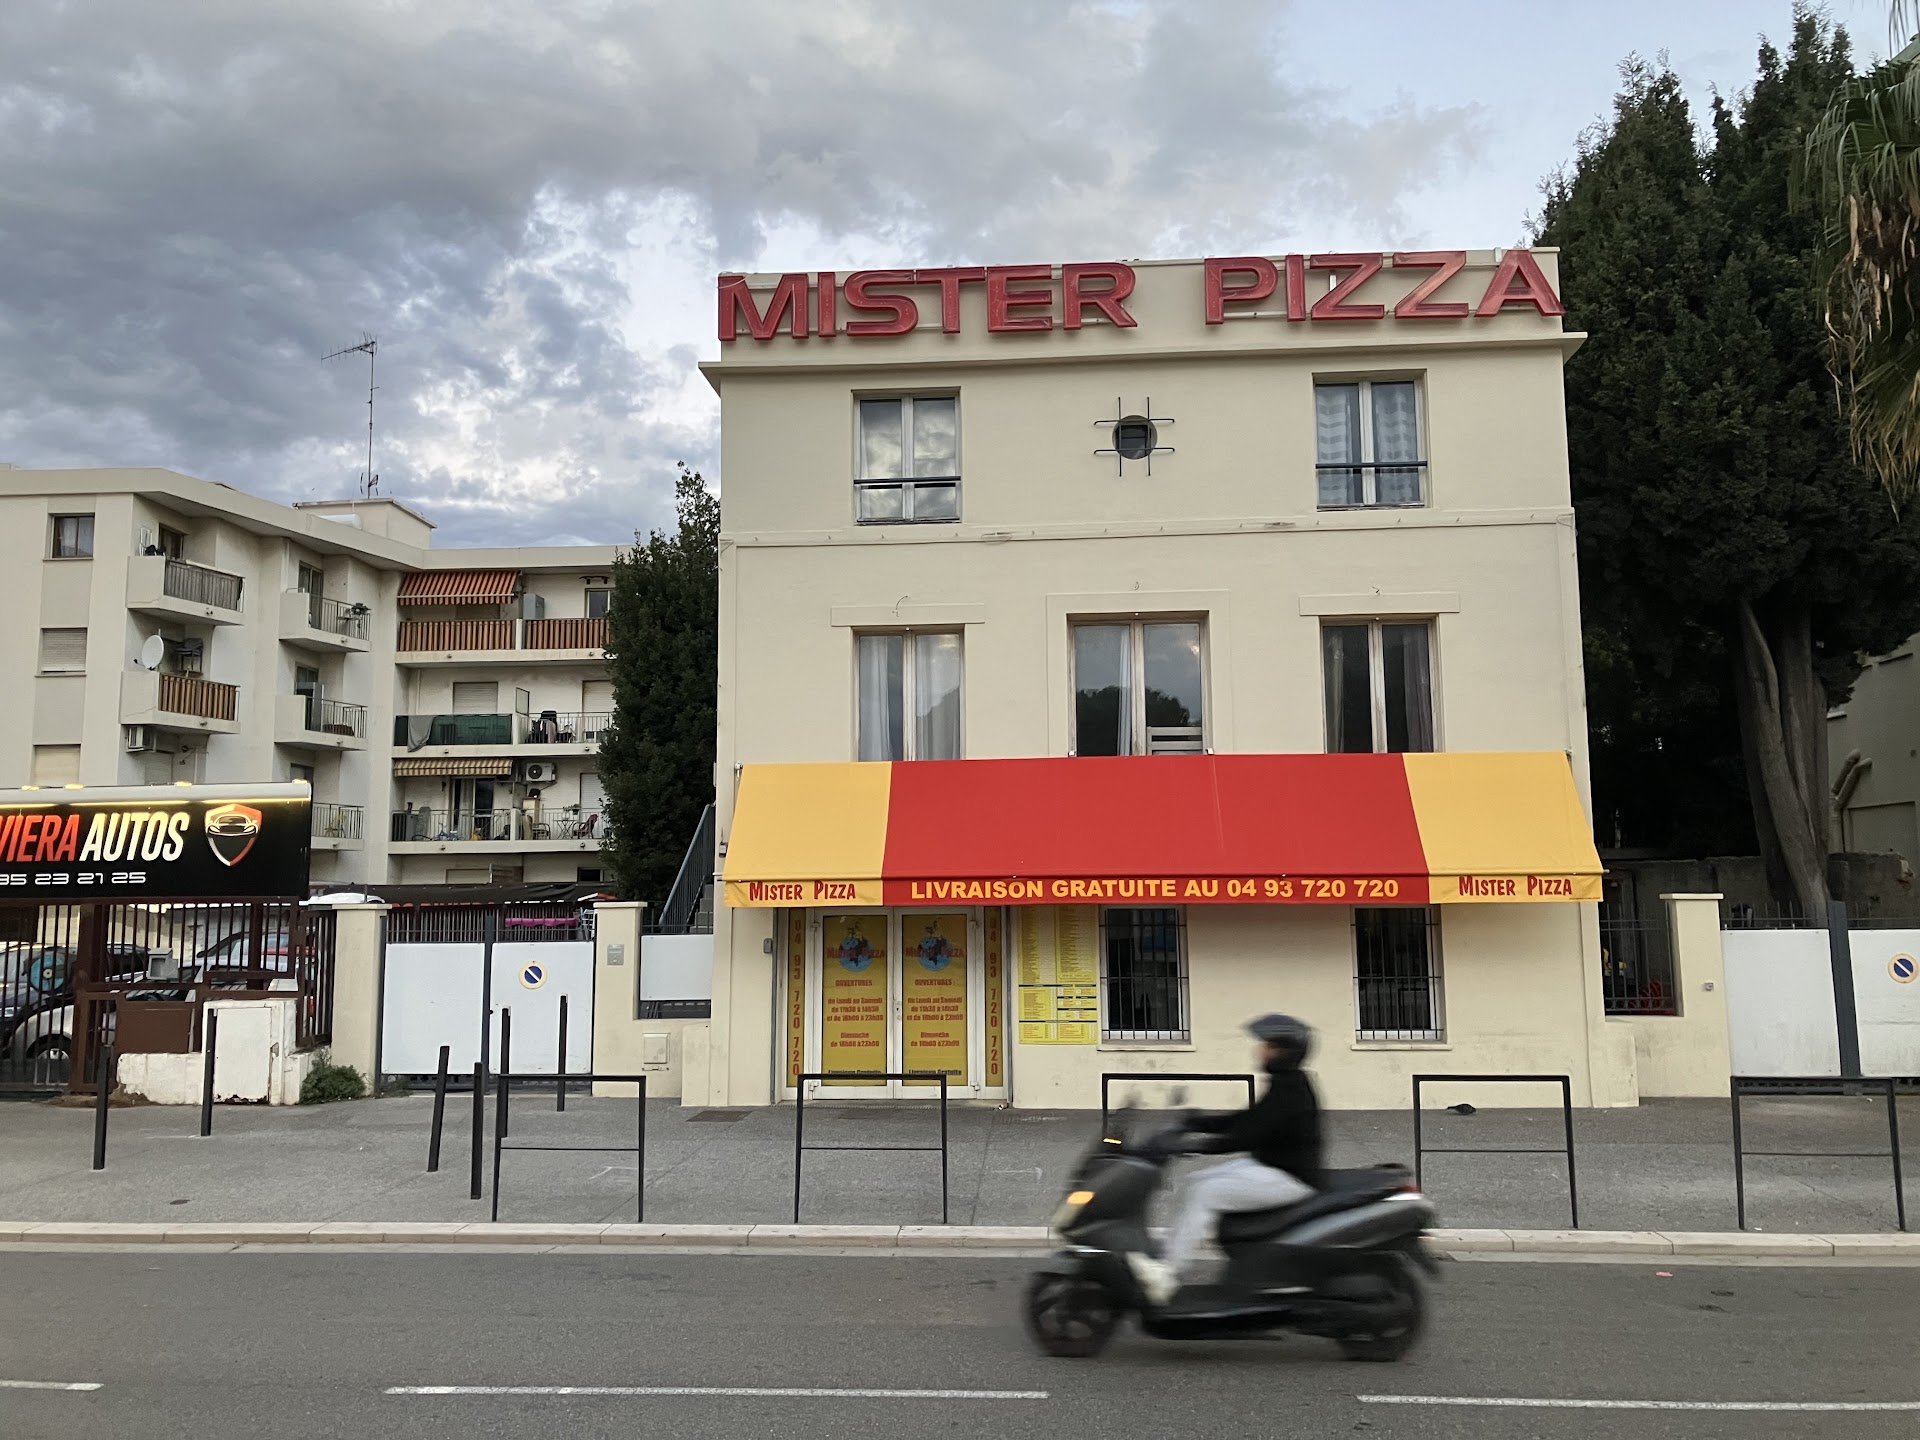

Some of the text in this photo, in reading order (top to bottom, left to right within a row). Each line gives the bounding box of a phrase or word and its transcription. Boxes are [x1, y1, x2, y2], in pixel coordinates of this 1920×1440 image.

[718, 249, 1566, 341] MISTER PIZZA
[79, 811, 190, 862] AUTOS
[35, 873, 69, 885] 23
[77, 872, 103, 884] 21
[111, 871, 146, 884] 25
[1458, 874, 1572, 896] MISTER PIZZA
[750, 879, 856, 900] MISTER PIZZA
[911, 879, 1399, 899] LIVRAISON GRATUITE AU 04 93 720 720
